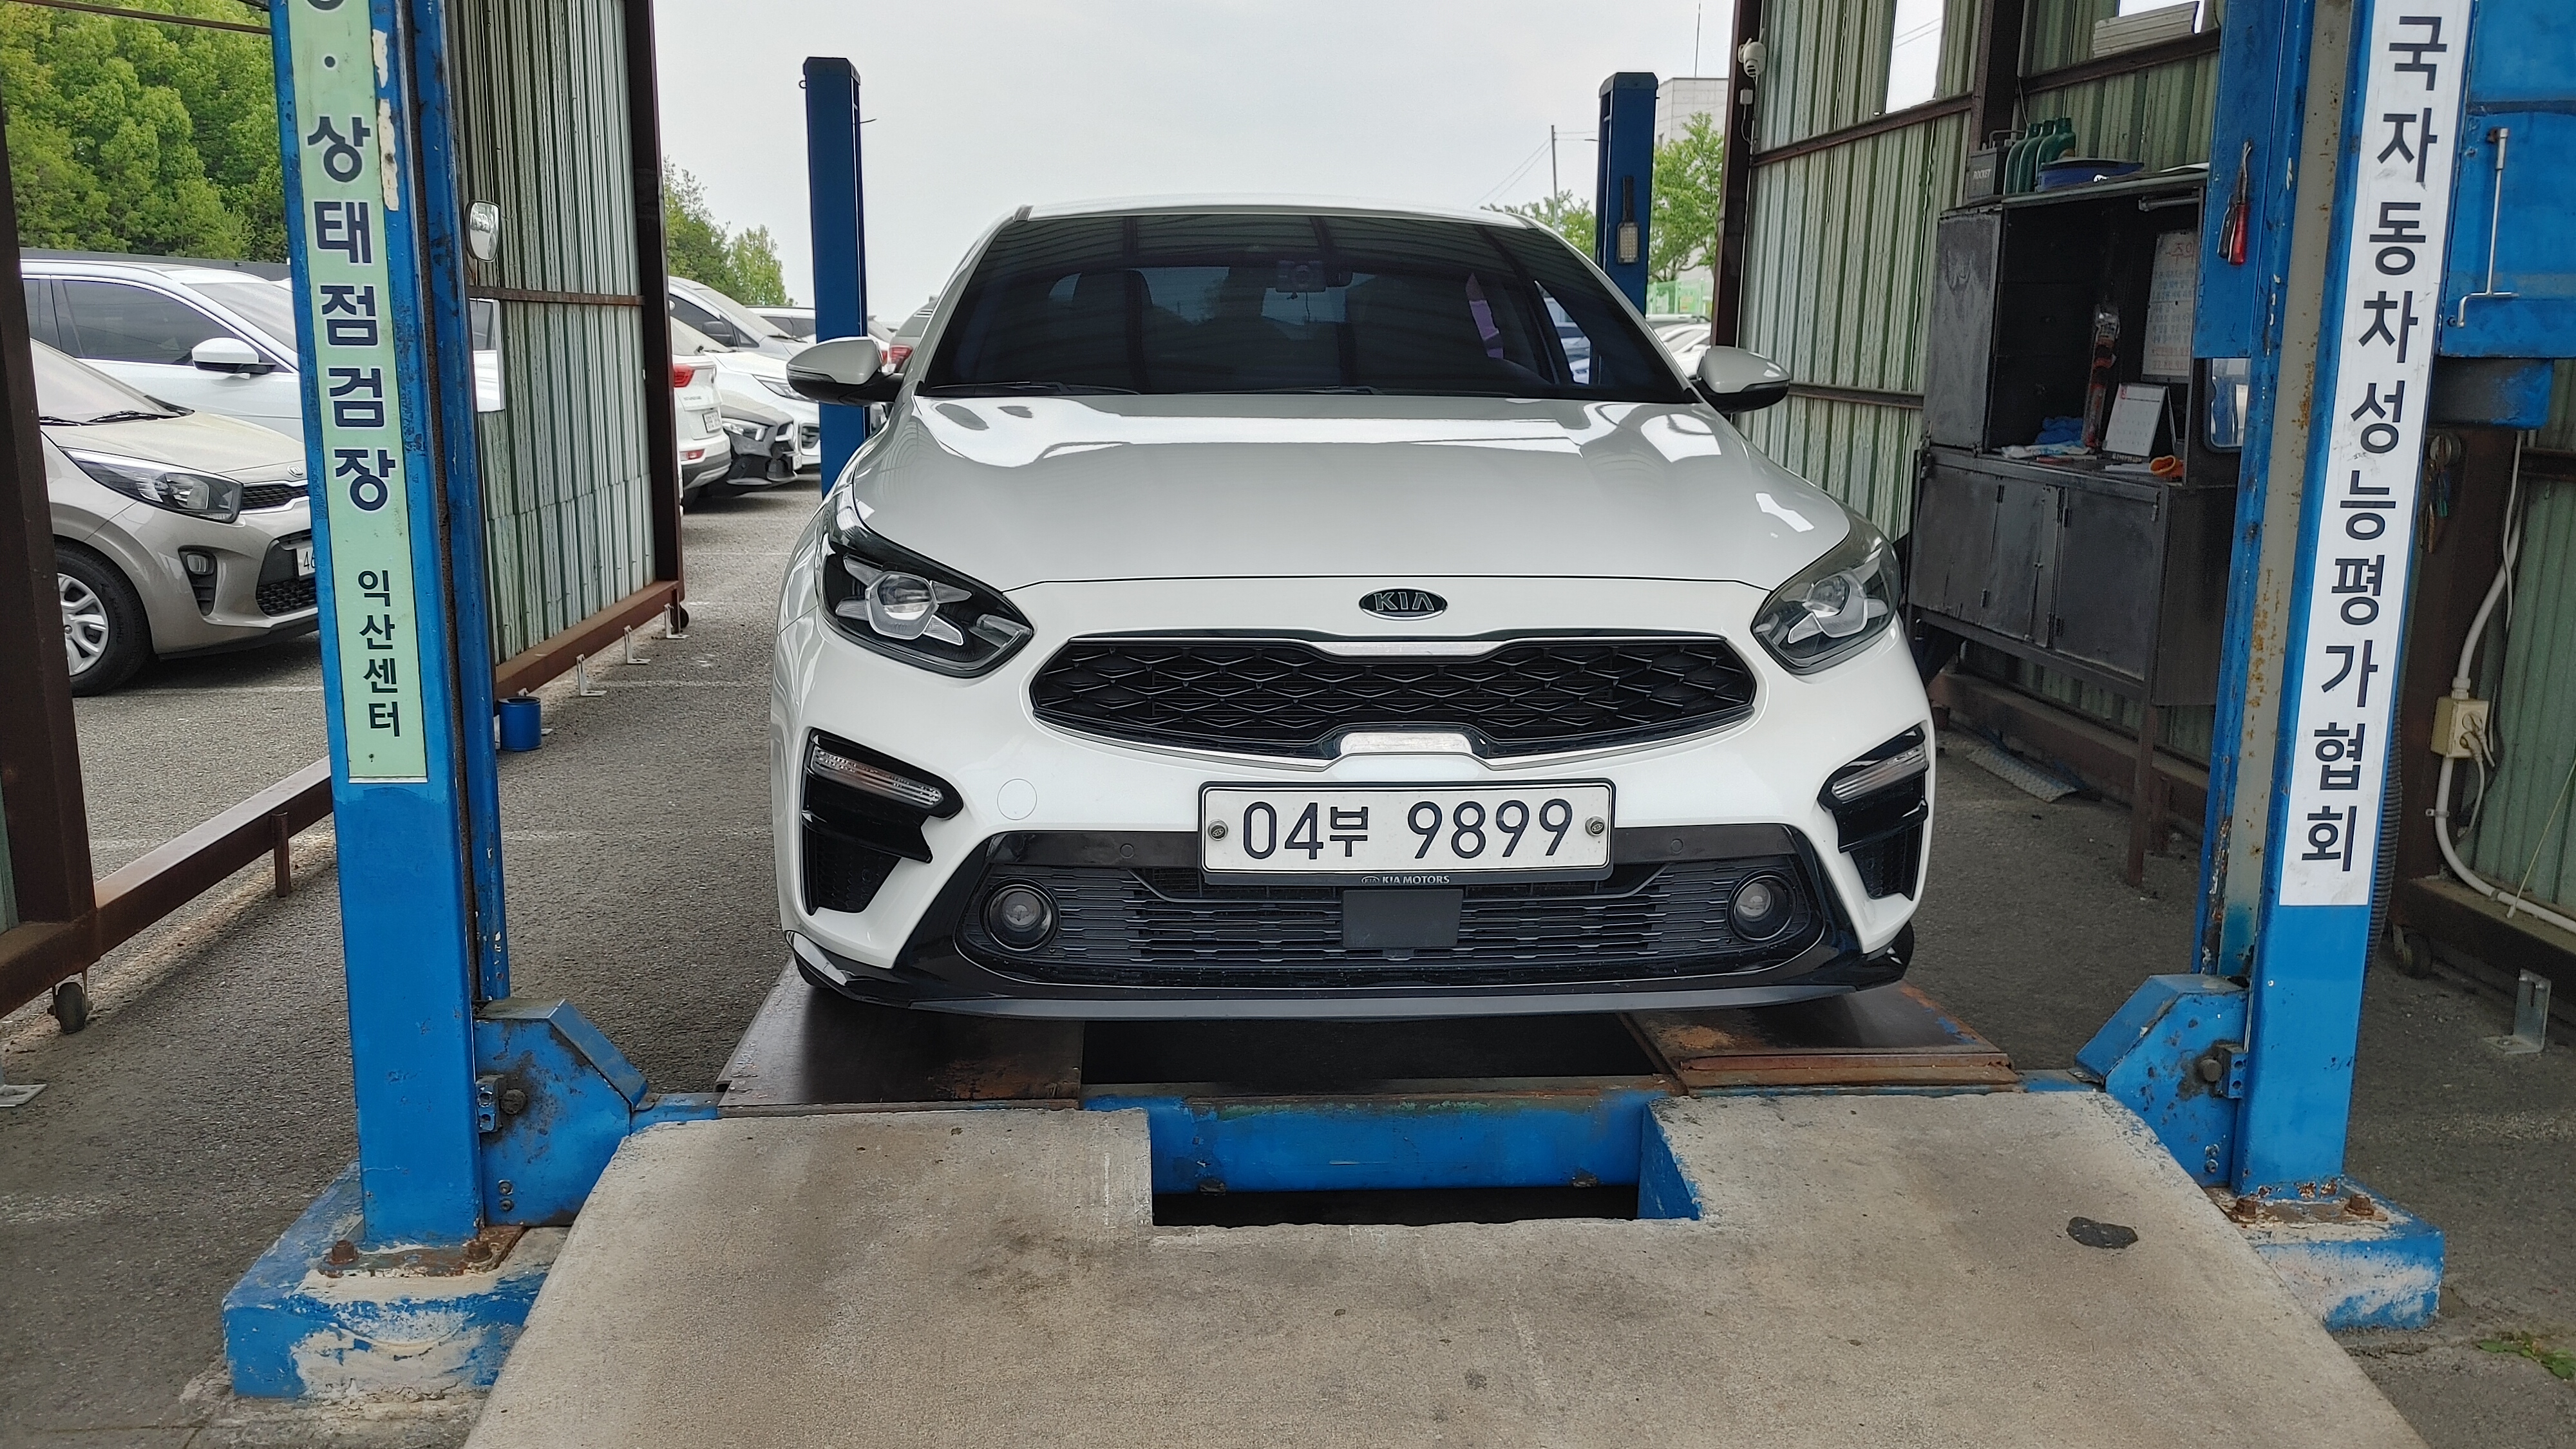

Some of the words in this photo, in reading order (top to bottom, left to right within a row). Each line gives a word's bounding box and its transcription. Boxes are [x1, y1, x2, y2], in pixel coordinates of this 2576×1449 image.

[2301, 16, 2447, 871] 국자동차성능평가협회
[1374, 592, 1434, 611] KIA
[358, 570, 401, 737] 익산센터
[1243, 801, 1368, 860] 04부
[1406, 798, 1574, 860] 9899
[1382, 876, 1401, 884] KIA
[1403, 875, 1450, 884] MOTORS
